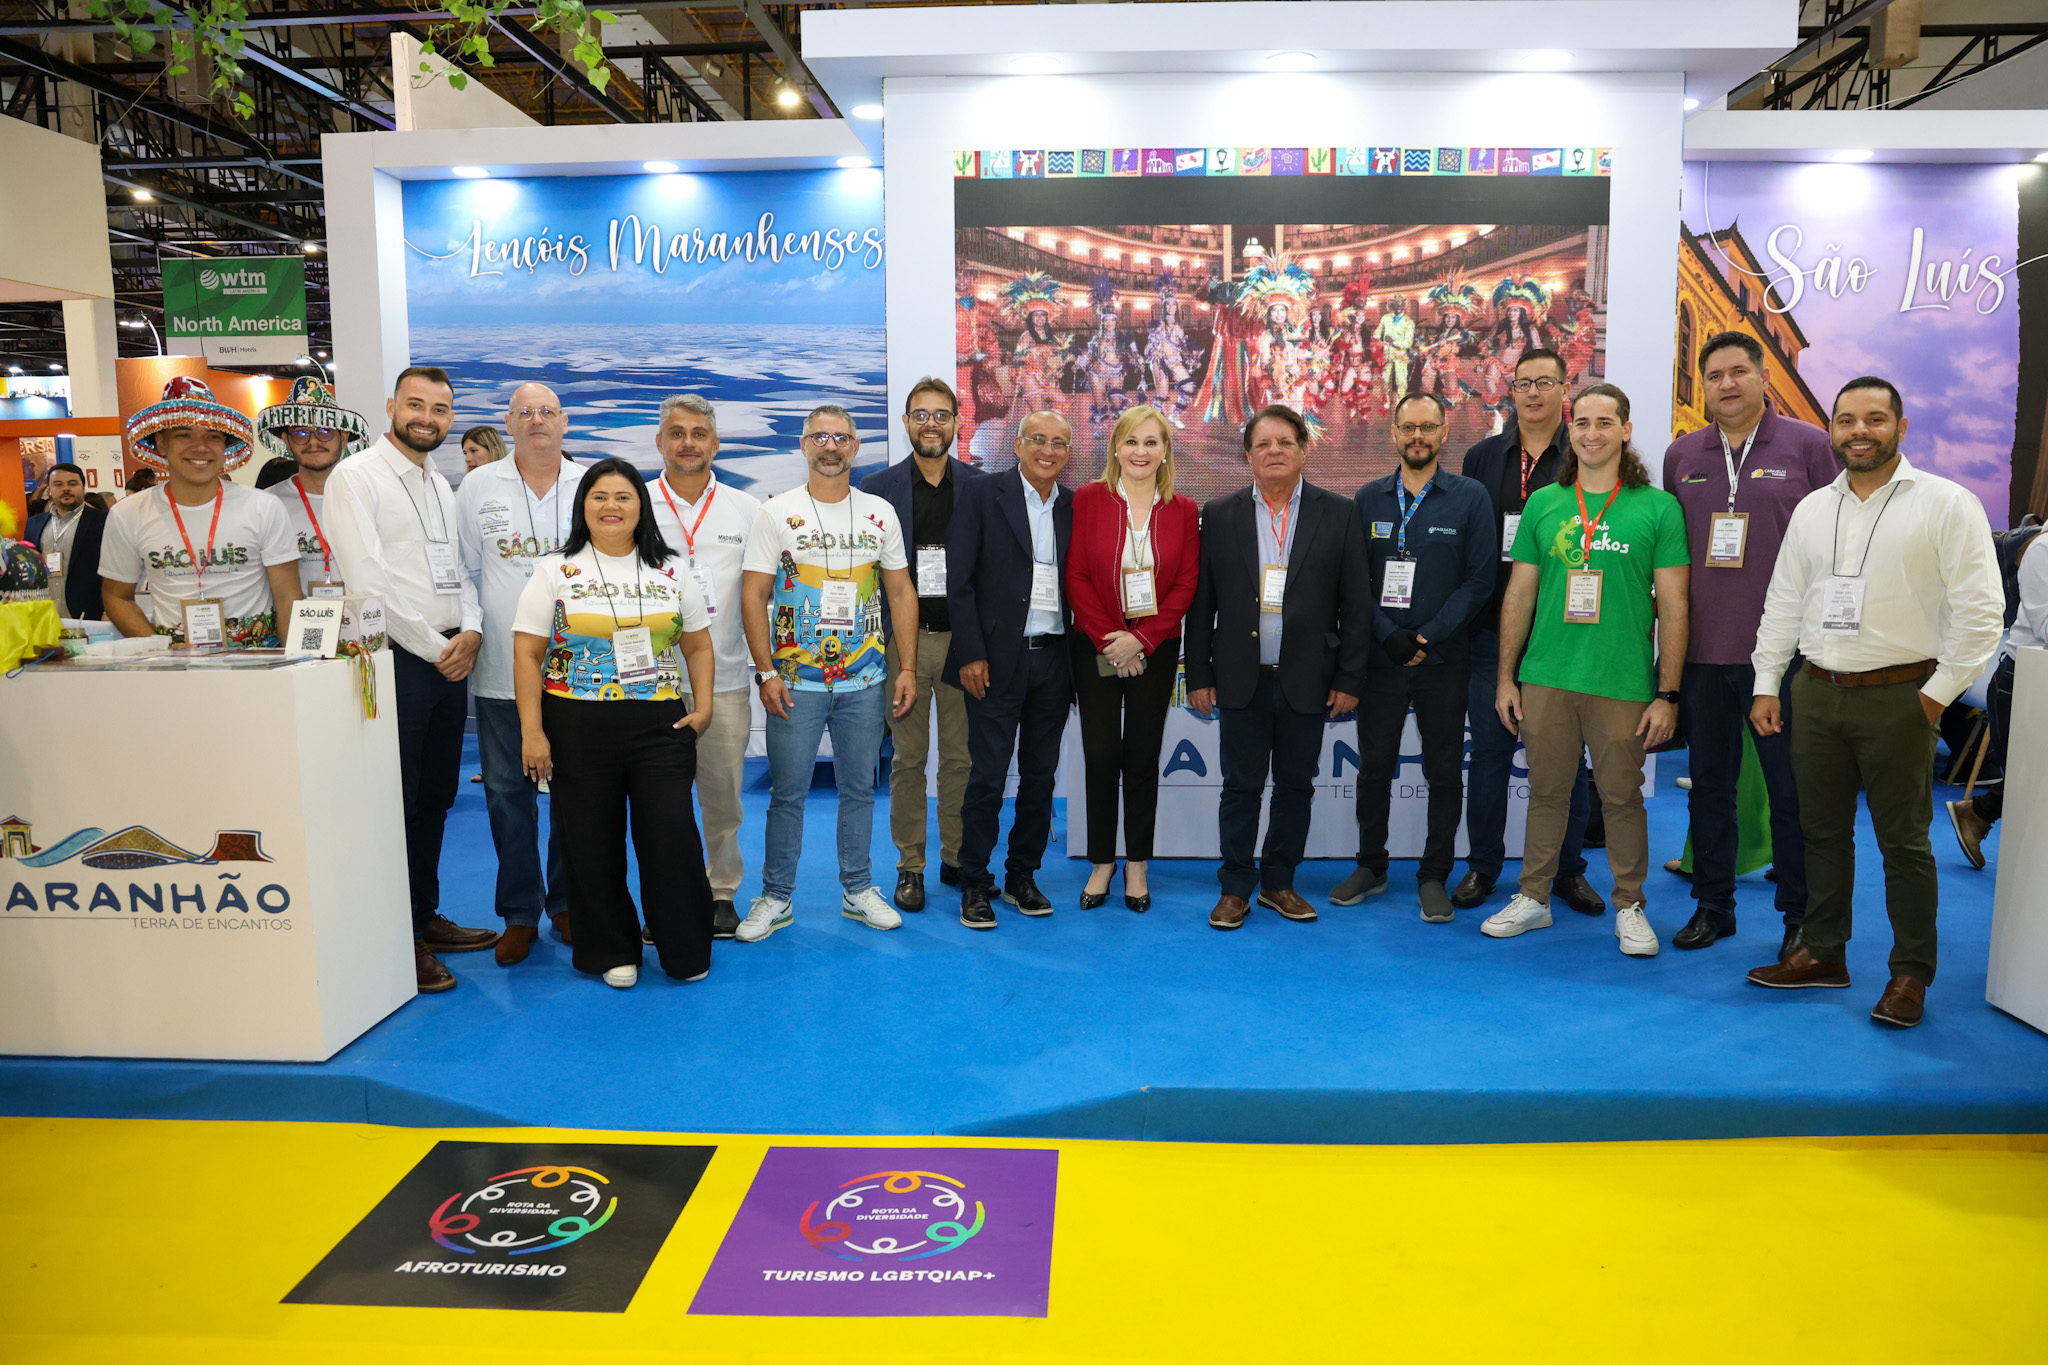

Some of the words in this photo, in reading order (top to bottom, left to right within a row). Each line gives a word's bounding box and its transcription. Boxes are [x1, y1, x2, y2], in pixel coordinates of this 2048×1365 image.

[404, 218, 592, 278] Lençóis
[608, 211, 884, 275] Maranhenses
[220, 268, 267, 287] wtm
[1750, 223, 1879, 314] São
[1899, 226, 2018, 315] Luís
[173, 315, 223, 333] North
[227, 315, 302, 332] America
[219, 346, 237, 354] BWH
[796, 529, 837, 551] SÃO
[570, 578, 620, 601] SÃO
[1400, 784, 1428, 799] DE
[5, 872, 291, 915] ARANHÃO
[131, 917, 178, 929] TERRA
[183, 918, 203, 929] DE
[208, 918, 292, 931] ENCANTOS
[488, 1207, 561, 1216] DIVERSIDADE
[856, 1213, 929, 1221] DIVERSIDADE
[394, 1260, 568, 1277] AFROTURISMO
[762, 1269, 865, 1282] TURISMO
[869, 1269, 996, 1283] LGBTQIAP+
